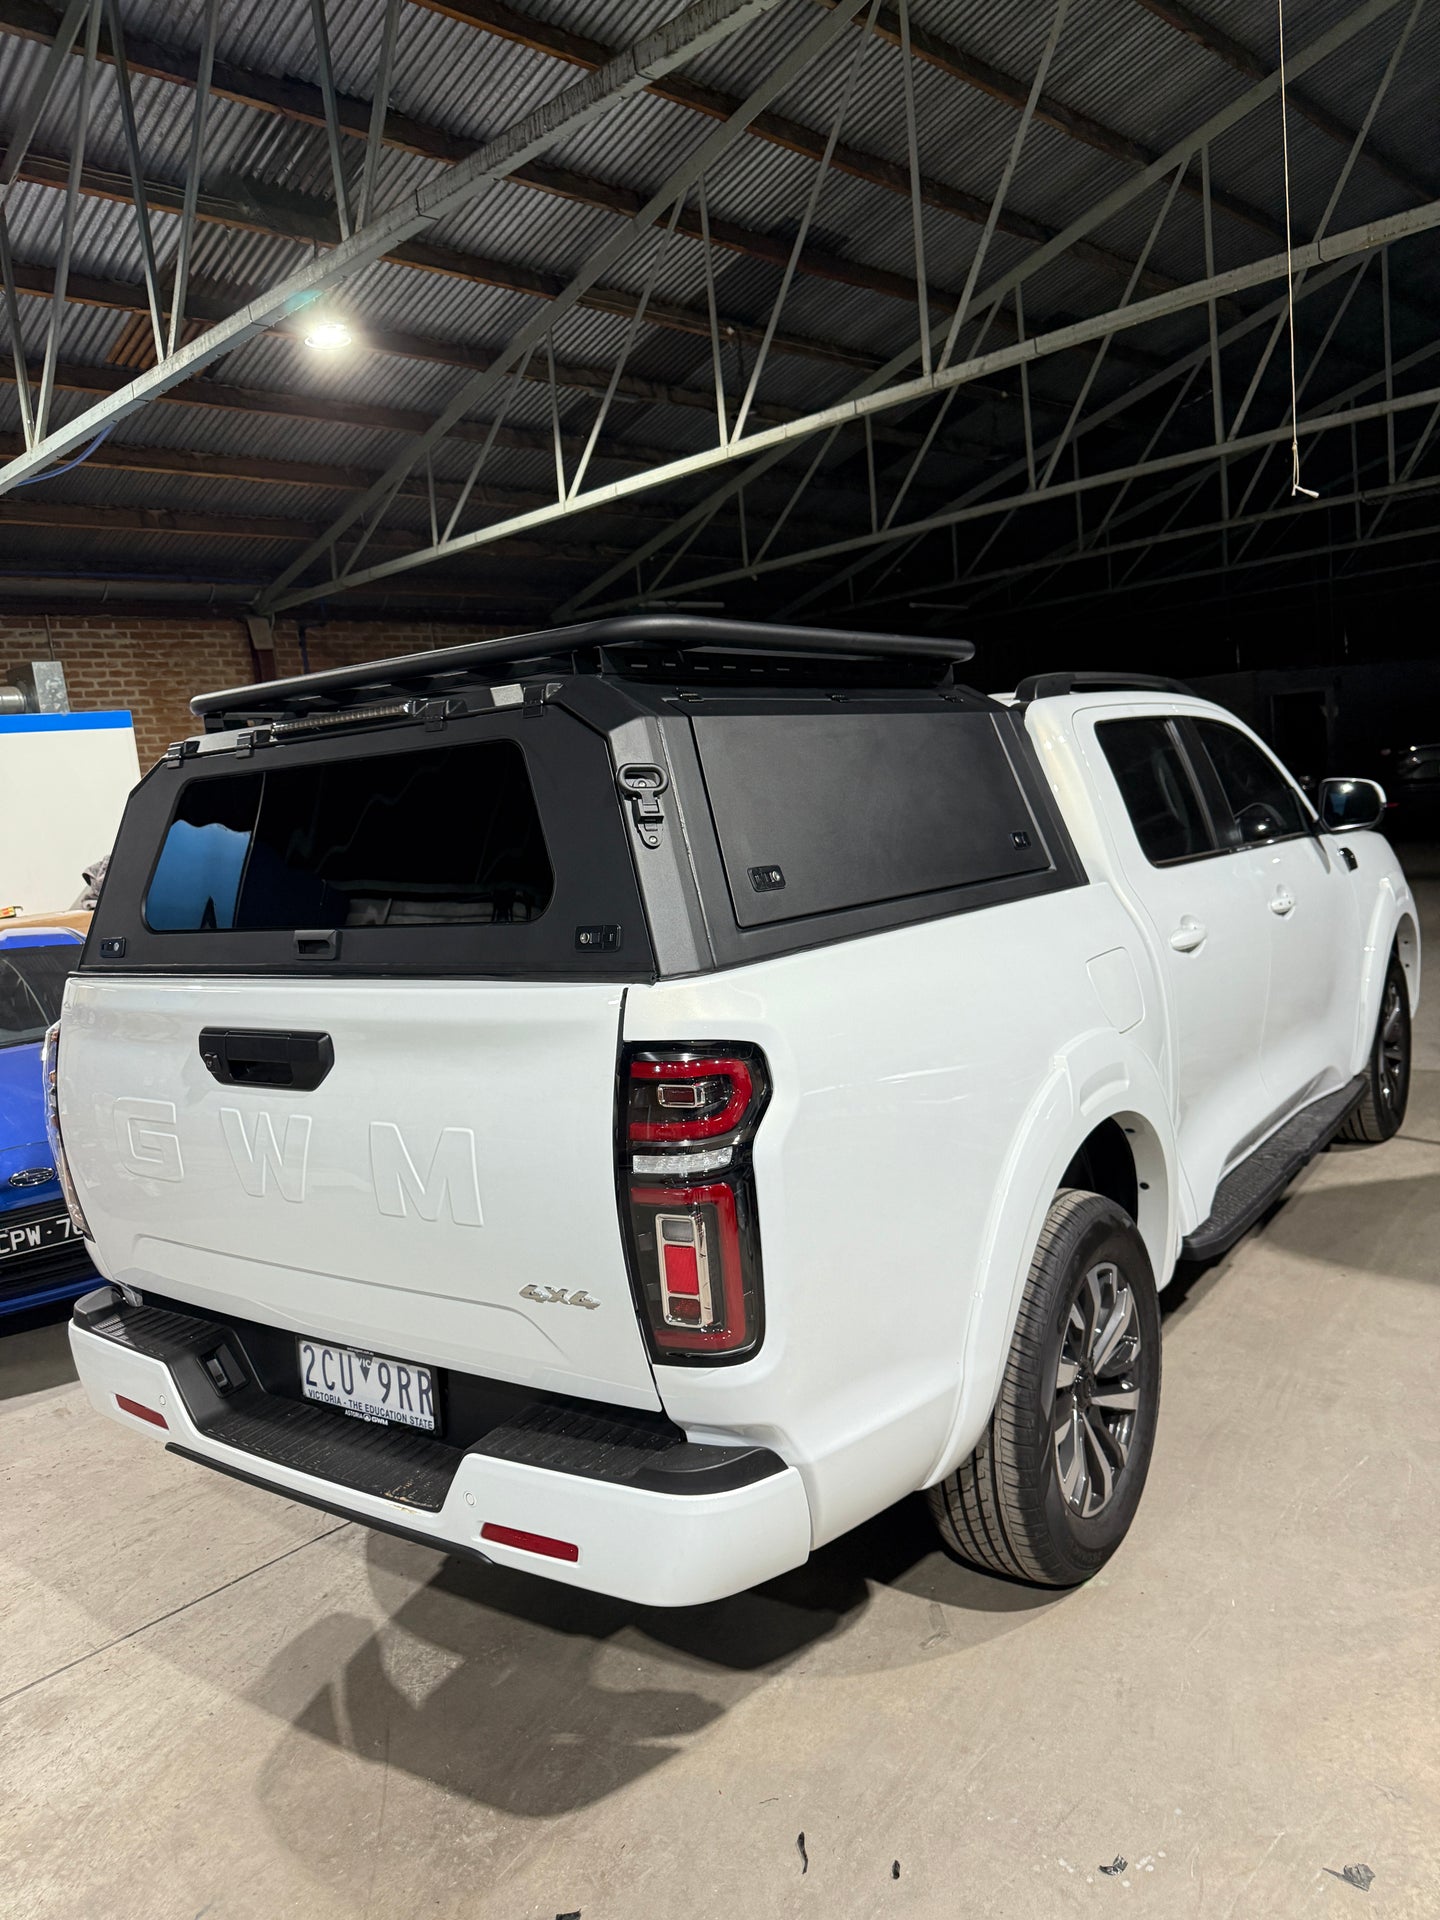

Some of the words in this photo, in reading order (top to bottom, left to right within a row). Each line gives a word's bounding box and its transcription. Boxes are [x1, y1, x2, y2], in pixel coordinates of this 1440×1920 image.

[113, 1097, 484, 1227] GWM
[303, 1344, 355, 1395] 2CU
[377, 1362, 434, 1417] 9RR
[358, 1358, 373, 1369] VIC
[308, 1388, 343, 1407] VICTORIA
[349, 1398, 363, 1412] THE
[364, 1402, 408, 1424] EDUCATION
[409, 1415, 433, 1430] STATE
